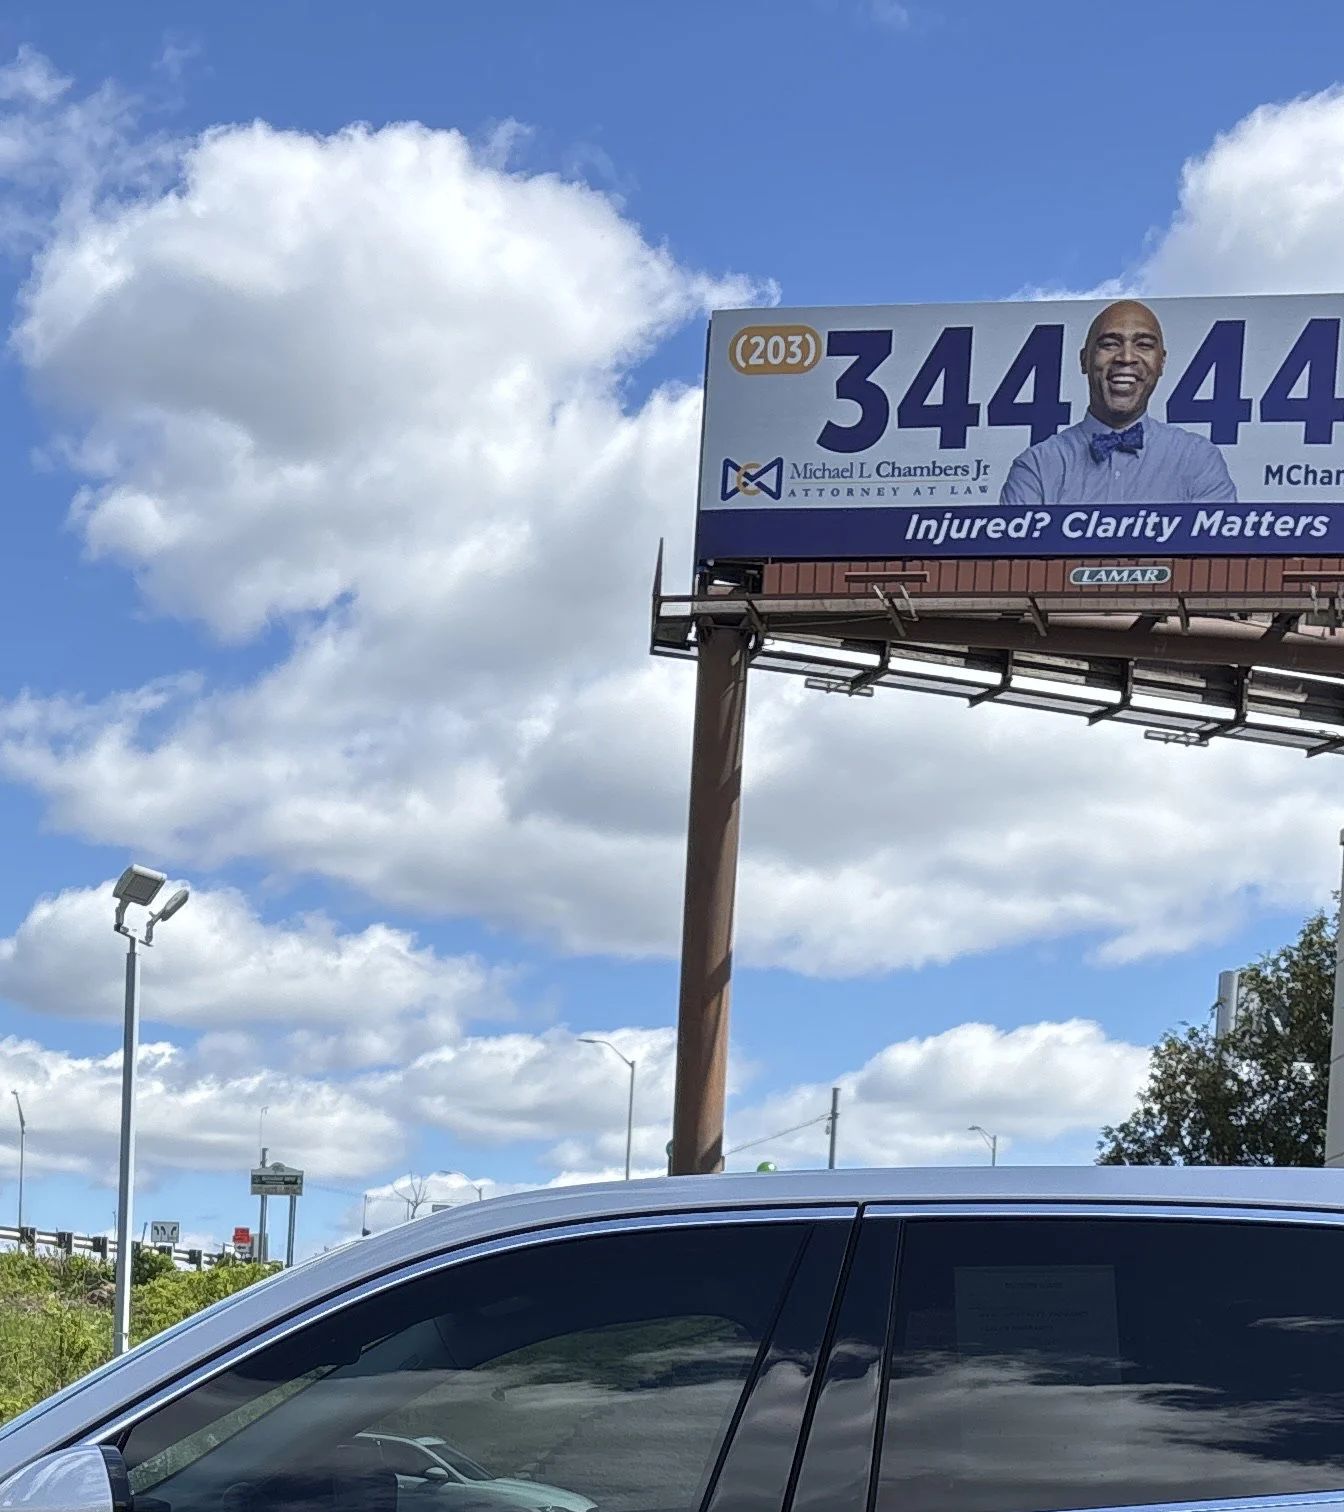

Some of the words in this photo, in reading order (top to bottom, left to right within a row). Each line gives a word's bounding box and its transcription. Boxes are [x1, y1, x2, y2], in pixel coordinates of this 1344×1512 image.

[735, 333, 817, 369] (203)
[815, 323, 1073, 454] 344
[789, 461, 854, 480] Michael
[858, 463, 872, 479] L
[875, 460, 970, 479] Chambers
[971, 458, 991, 482] Jr
[787, 486, 901, 498] ATTORNEY
[913, 485, 937, 497] AT
[950, 484, 990, 496] LAW
[904, 511, 1051, 545] Injured?
[1060, 510, 1182, 543] Clarity
[1190, 509, 1329, 538] Matters
[1080, 567, 1159, 583] LAMAR
